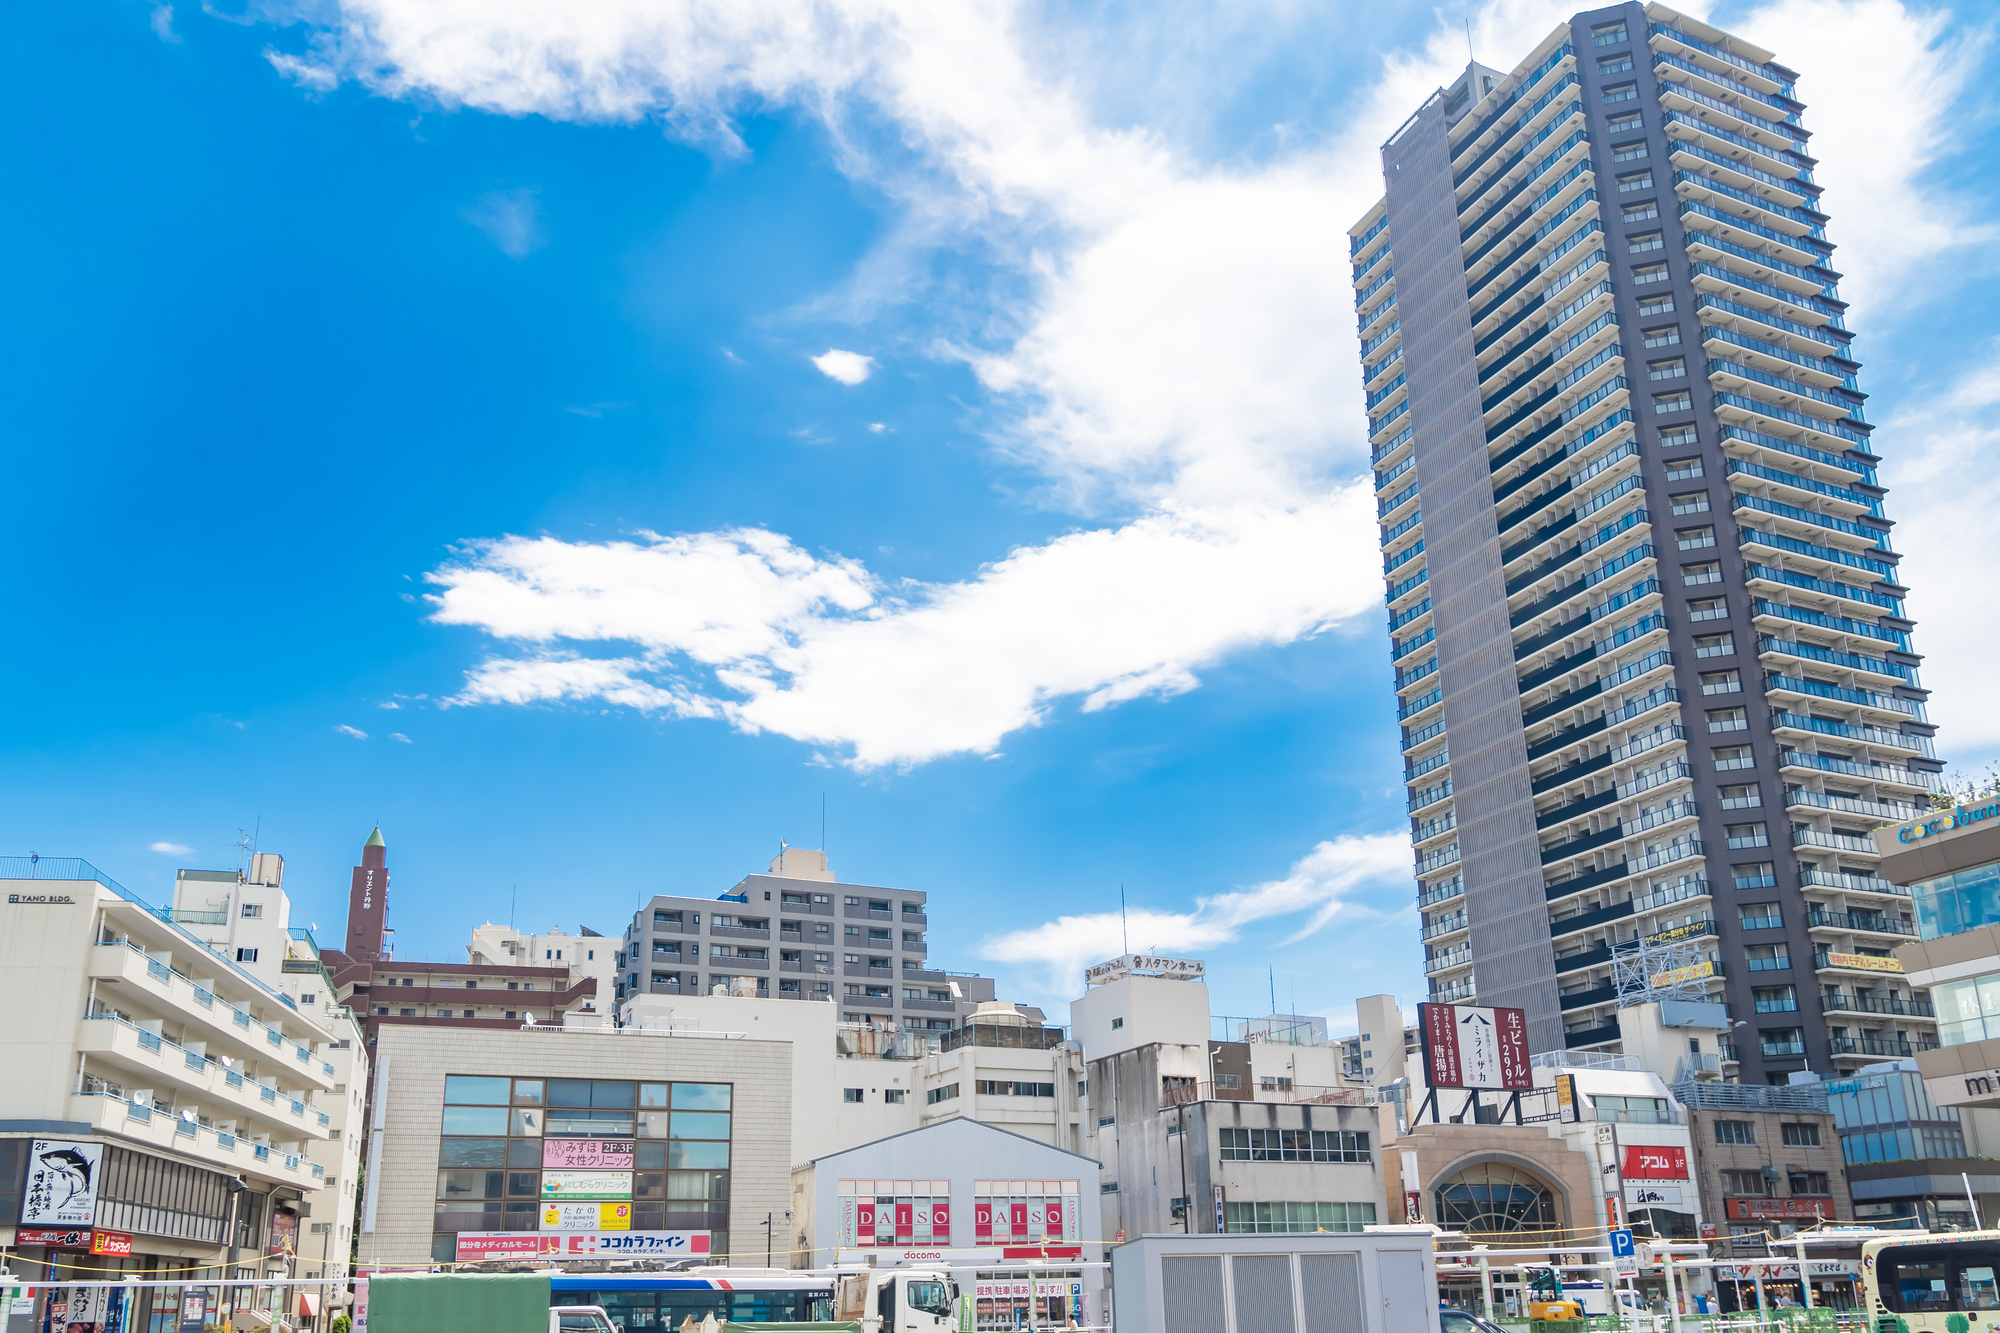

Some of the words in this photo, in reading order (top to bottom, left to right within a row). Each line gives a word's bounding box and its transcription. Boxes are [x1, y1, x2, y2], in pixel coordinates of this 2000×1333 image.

[49, 895, 73, 903] BLDG.
[1145, 957, 1204, 973] ハタマンホール
[1507, 1012, 1527, 1078] 生ビール
[1474, 1025, 1486, 1083] ミライザカ
[1865, 1080, 1885, 1089] EAST
[1599, 1127, 1610, 1135] 近藤
[1600, 1134, 1612, 1143] ビル
[35, 1142, 49, 1151] 2F
[565, 1142, 597, 1153] みずほ
[565, 1154, 633, 1167] 女性クリニック
[1640, 1155, 1670, 1169] アコム
[1674, 1159, 1685, 1168] 3F
[564, 1180, 628, 1189] にしむらクリニック
[563, 1206, 595, 1215] たかの
[617, 1207, 627, 1216] 2F
[860, 1210, 948, 1225] DAISO
[977, 1210, 1061, 1224] DAISO
[563, 1221, 595, 1229] クリニック
[459, 1240, 536, 1250] 国分寺メディカルモール
[600, 1235, 685, 1248] ココカラファイン
[1616, 1233, 1629, 1254] P
[1881, 1239, 1915, 1247] KOKUBUNJI
[1936, 1236, 1972, 1244] KOKUBUNJI
[109, 1240, 131, 1253] サンドラッグ
[904, 1250, 941, 1260] docomo
[1818, 1263, 1841, 1273] 富士そば
[1072, 1284, 1080, 1294] P
[1070, 1304, 1081, 1312] 5G
